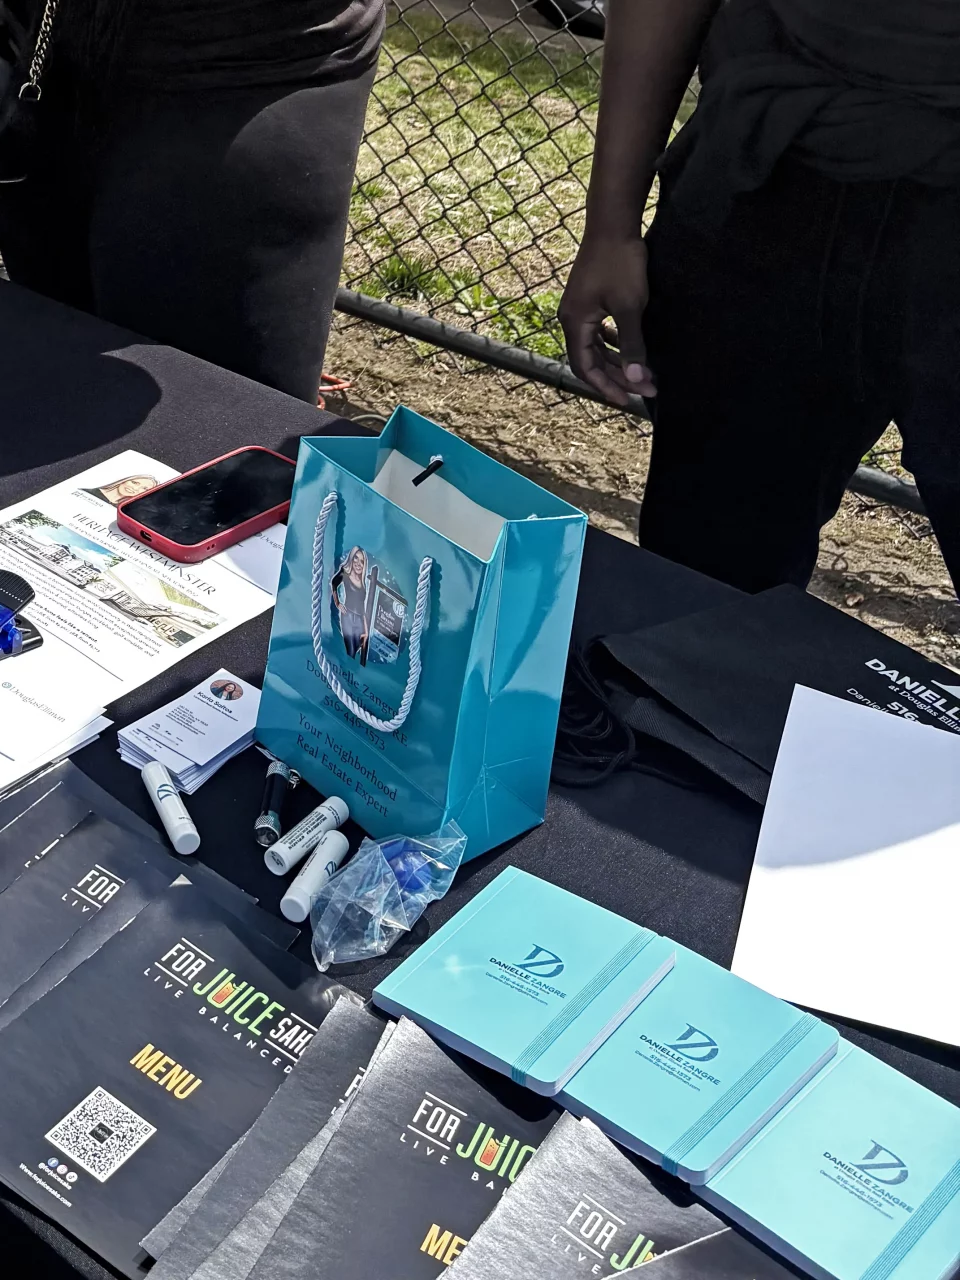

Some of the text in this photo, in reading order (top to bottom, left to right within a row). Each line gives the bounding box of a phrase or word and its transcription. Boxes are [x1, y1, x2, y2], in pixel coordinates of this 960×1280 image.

[323, 658, 361, 689] anielle
[865, 659, 960, 723] DANIELL
[888, 685, 900, 693] at
[899, 690, 939, 717] Douglas
[298, 711, 400, 804] Your Neighborhood
[390, 725, 410, 748] RE
[295, 730, 390, 820] Real Estate Expert
[61, 893, 89, 913] LIV
[77, 869, 121, 904] FOR
[161, 942, 207, 982] FOR
[192, 968, 286, 1037] JUICE
[489, 957, 567, 999] DANIELLE ZANGRE
[143, 967, 293, 1074] LIVE BALANCED
[129, 1043, 202, 1100] MENU
[640, 1034, 721, 1085] DANIELLE ZANGRE
[400, 1132, 449, 1165] LIVE
[412, 1099, 536, 1183] FOR JUIC
[823, 1152, 914, 1214] DANIELLE ZANGRE
[419, 1223, 469, 1266] ME
[566, 1200, 618, 1251] FOR
[551, 1233, 602, 1274] LIVE
